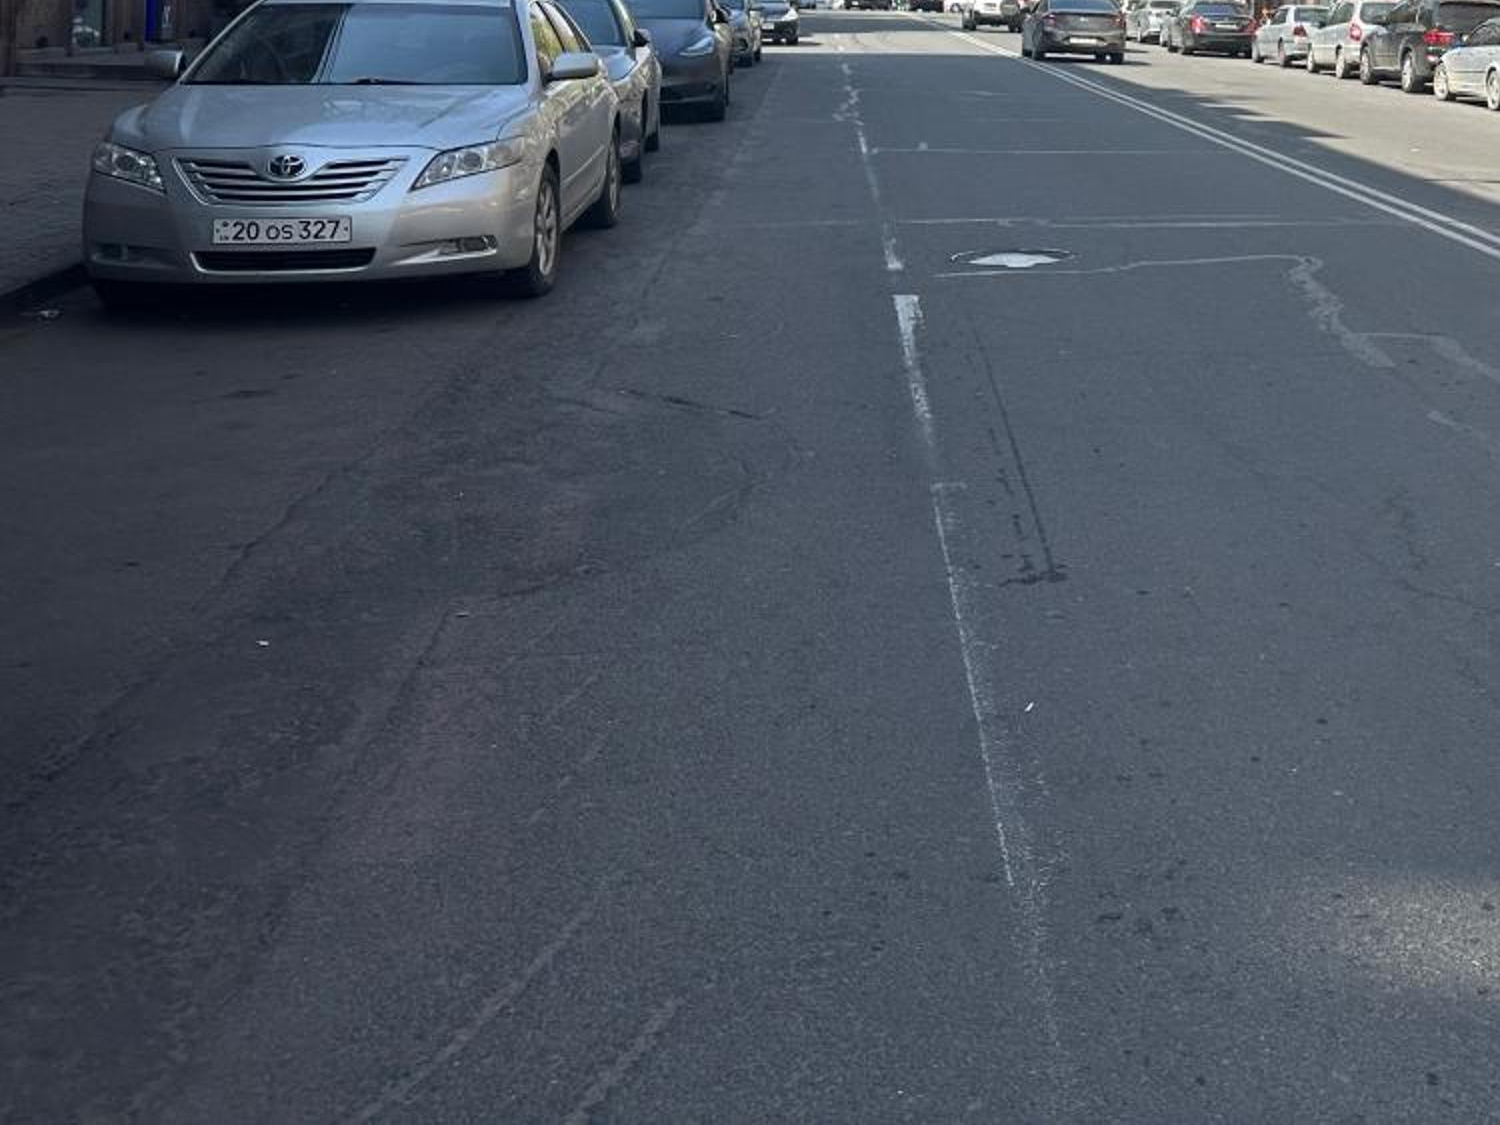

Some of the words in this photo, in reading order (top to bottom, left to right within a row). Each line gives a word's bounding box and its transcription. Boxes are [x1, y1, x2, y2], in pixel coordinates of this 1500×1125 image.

[231, 220, 260, 241] 20
[265, 224, 294, 240] OS
[298, 219, 341, 240] 327
